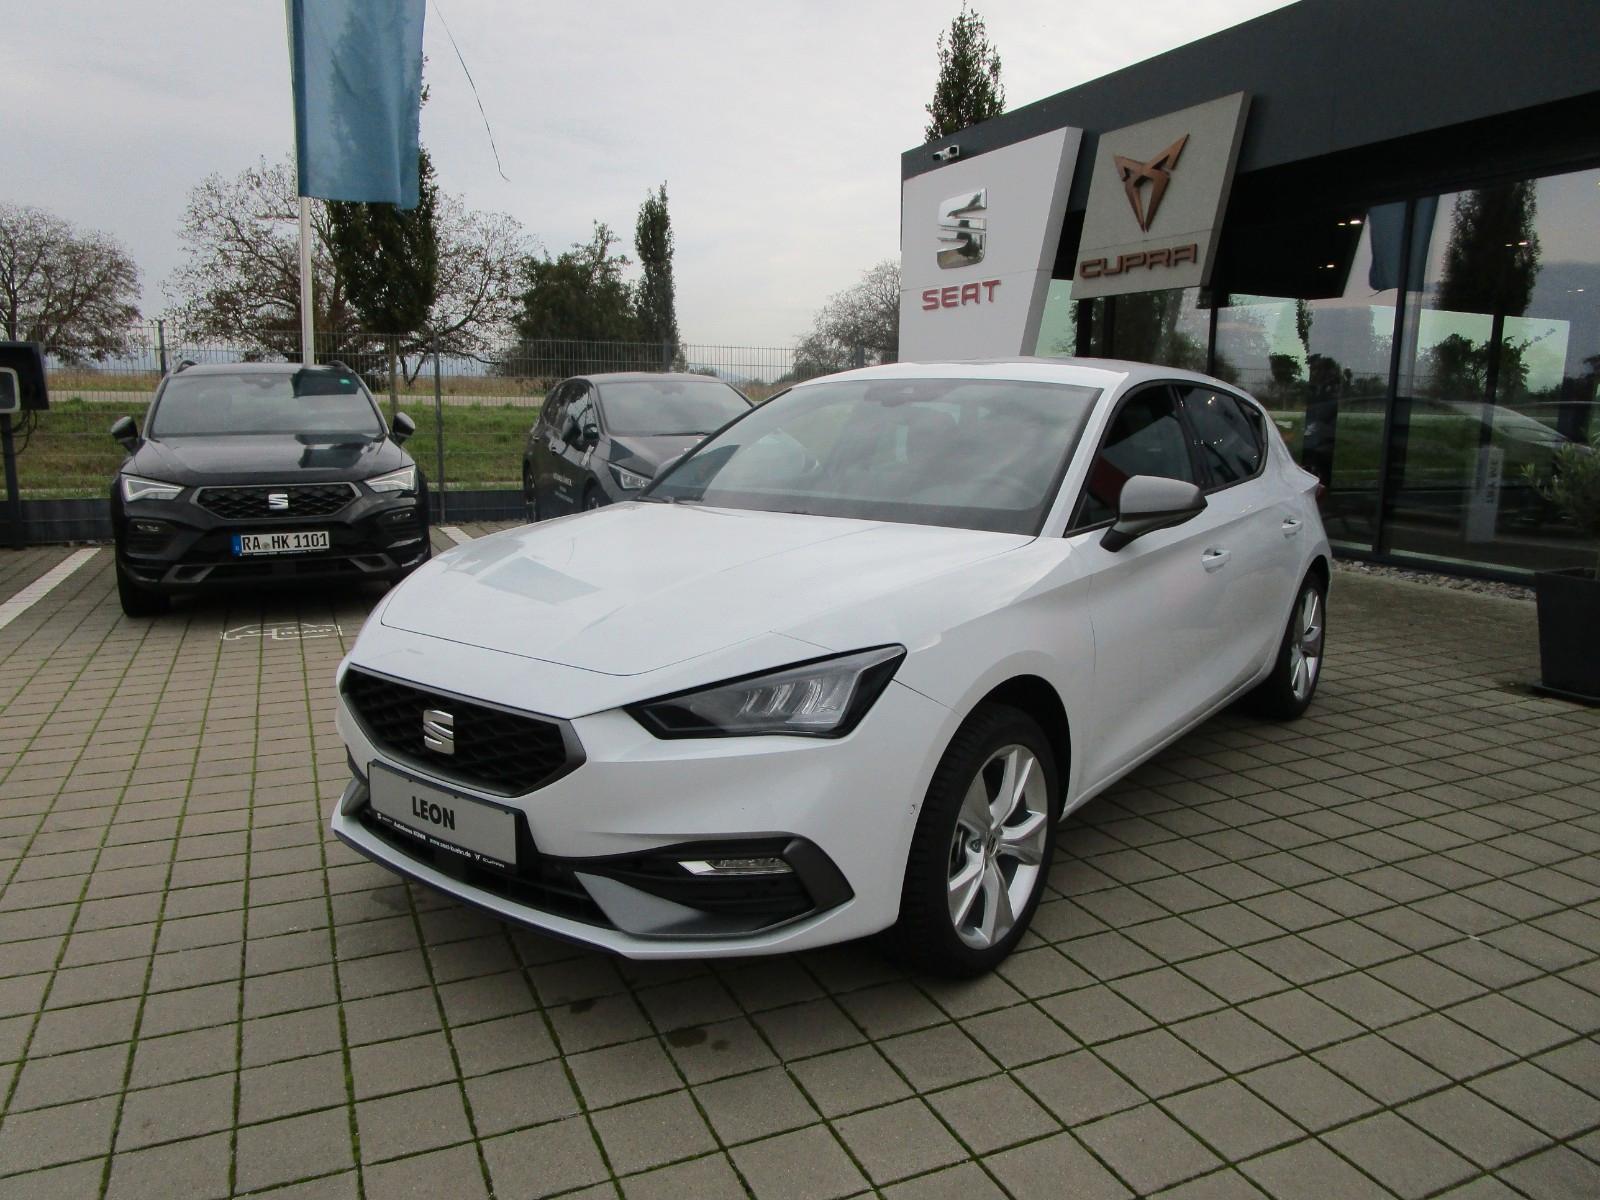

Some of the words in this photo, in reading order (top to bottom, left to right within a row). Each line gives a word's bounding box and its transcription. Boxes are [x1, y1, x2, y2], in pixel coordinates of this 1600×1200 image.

[1079, 243, 1197, 279] CUPRA
[922, 280, 1001, 310] SEAT
[242, 536, 261, 551] RA
[272, 535, 290, 549] HK
[294, 533, 328, 548] 1101
[412, 796, 456, 831] LEON
